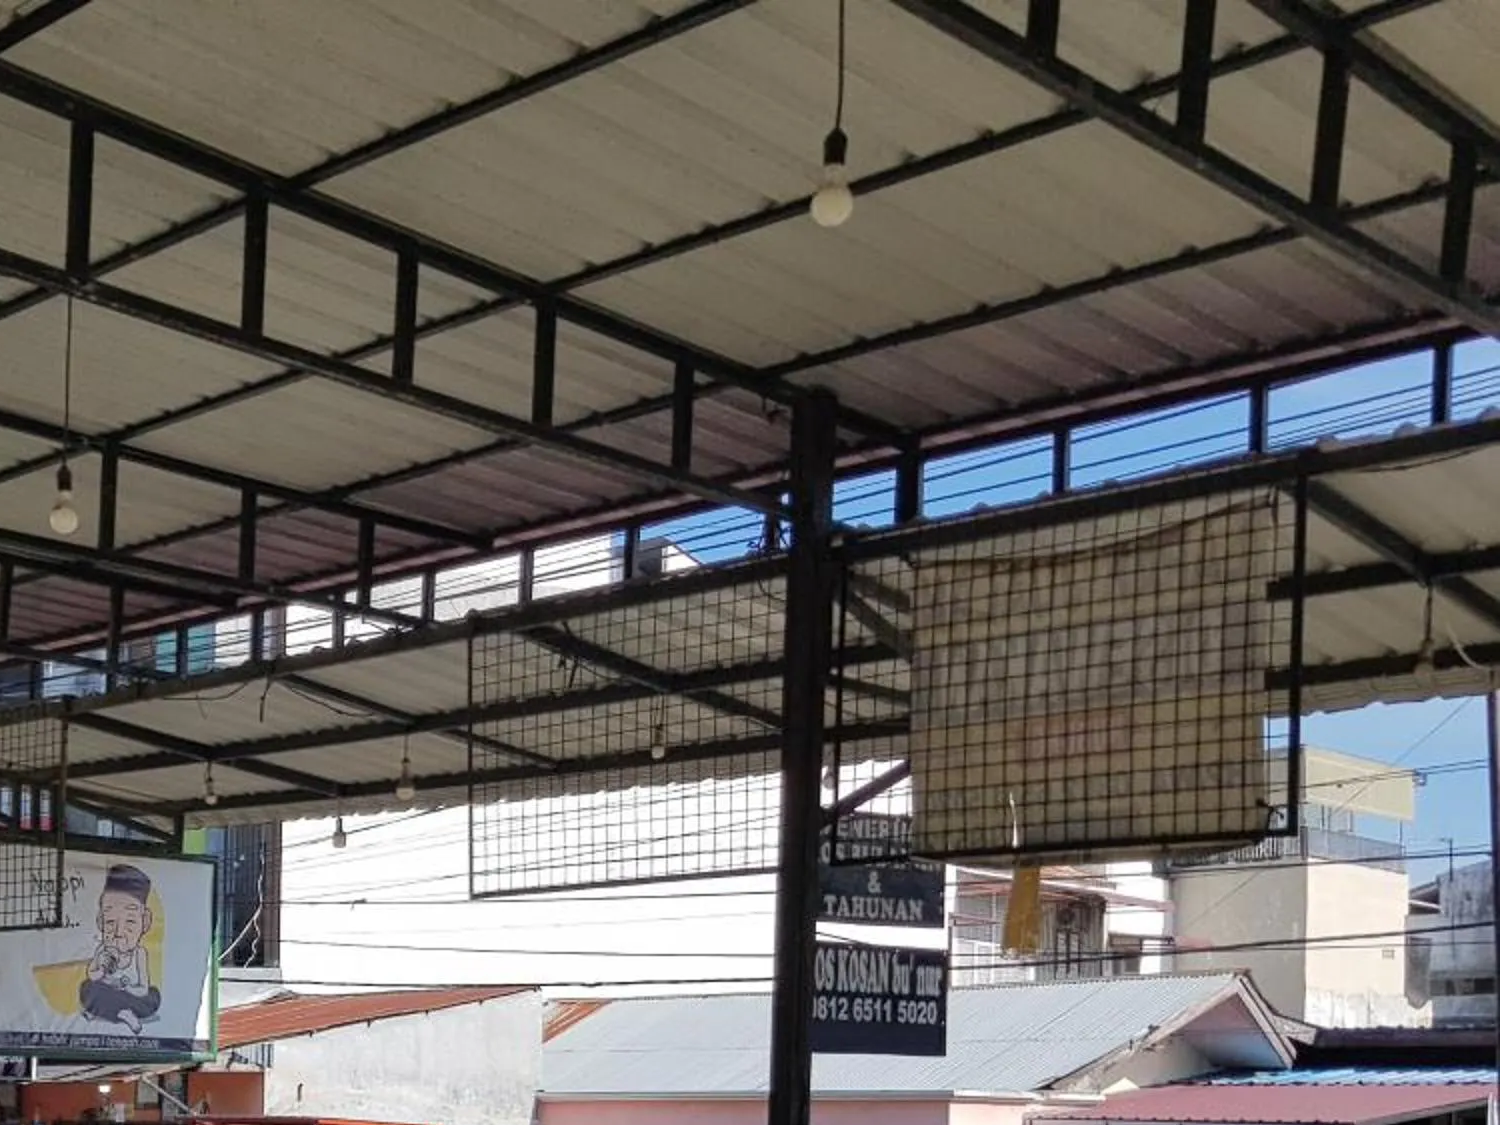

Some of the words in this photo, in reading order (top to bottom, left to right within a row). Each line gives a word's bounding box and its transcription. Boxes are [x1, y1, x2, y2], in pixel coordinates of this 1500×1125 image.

[867, 871, 882, 893] &
[823, 894, 924, 921] TAHUNAN
[814, 947, 835, 991] OS
[837, 949, 890, 994] KOSAN
[853, 998, 892, 1023] 6511
[897, 1000, 938, 1025] 5020
